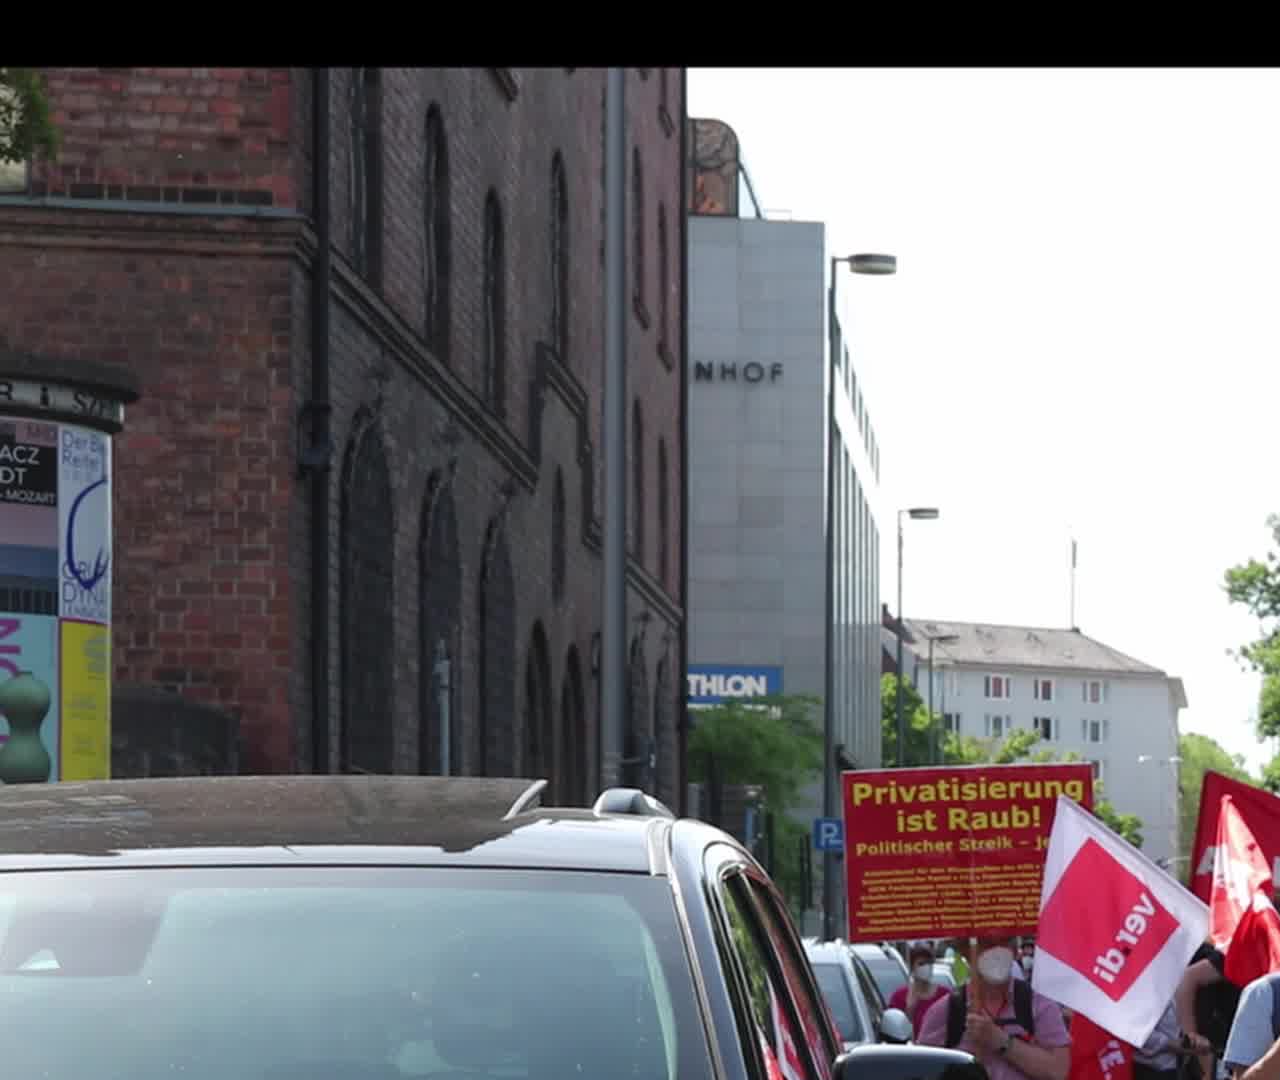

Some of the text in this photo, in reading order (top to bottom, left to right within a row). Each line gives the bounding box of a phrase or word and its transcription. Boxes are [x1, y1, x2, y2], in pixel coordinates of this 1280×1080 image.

[695, 361, 784, 384] NHOF
[0, 445, 41, 465] ACZ
[687, 673, 768, 697] THLON
[852, 777, 1084, 805] Privatisierung
[896, 805, 1041, 833] ist Raub!
[856, 839, 953, 857] Politischer
[959, 835, 1013, 852] Streik
